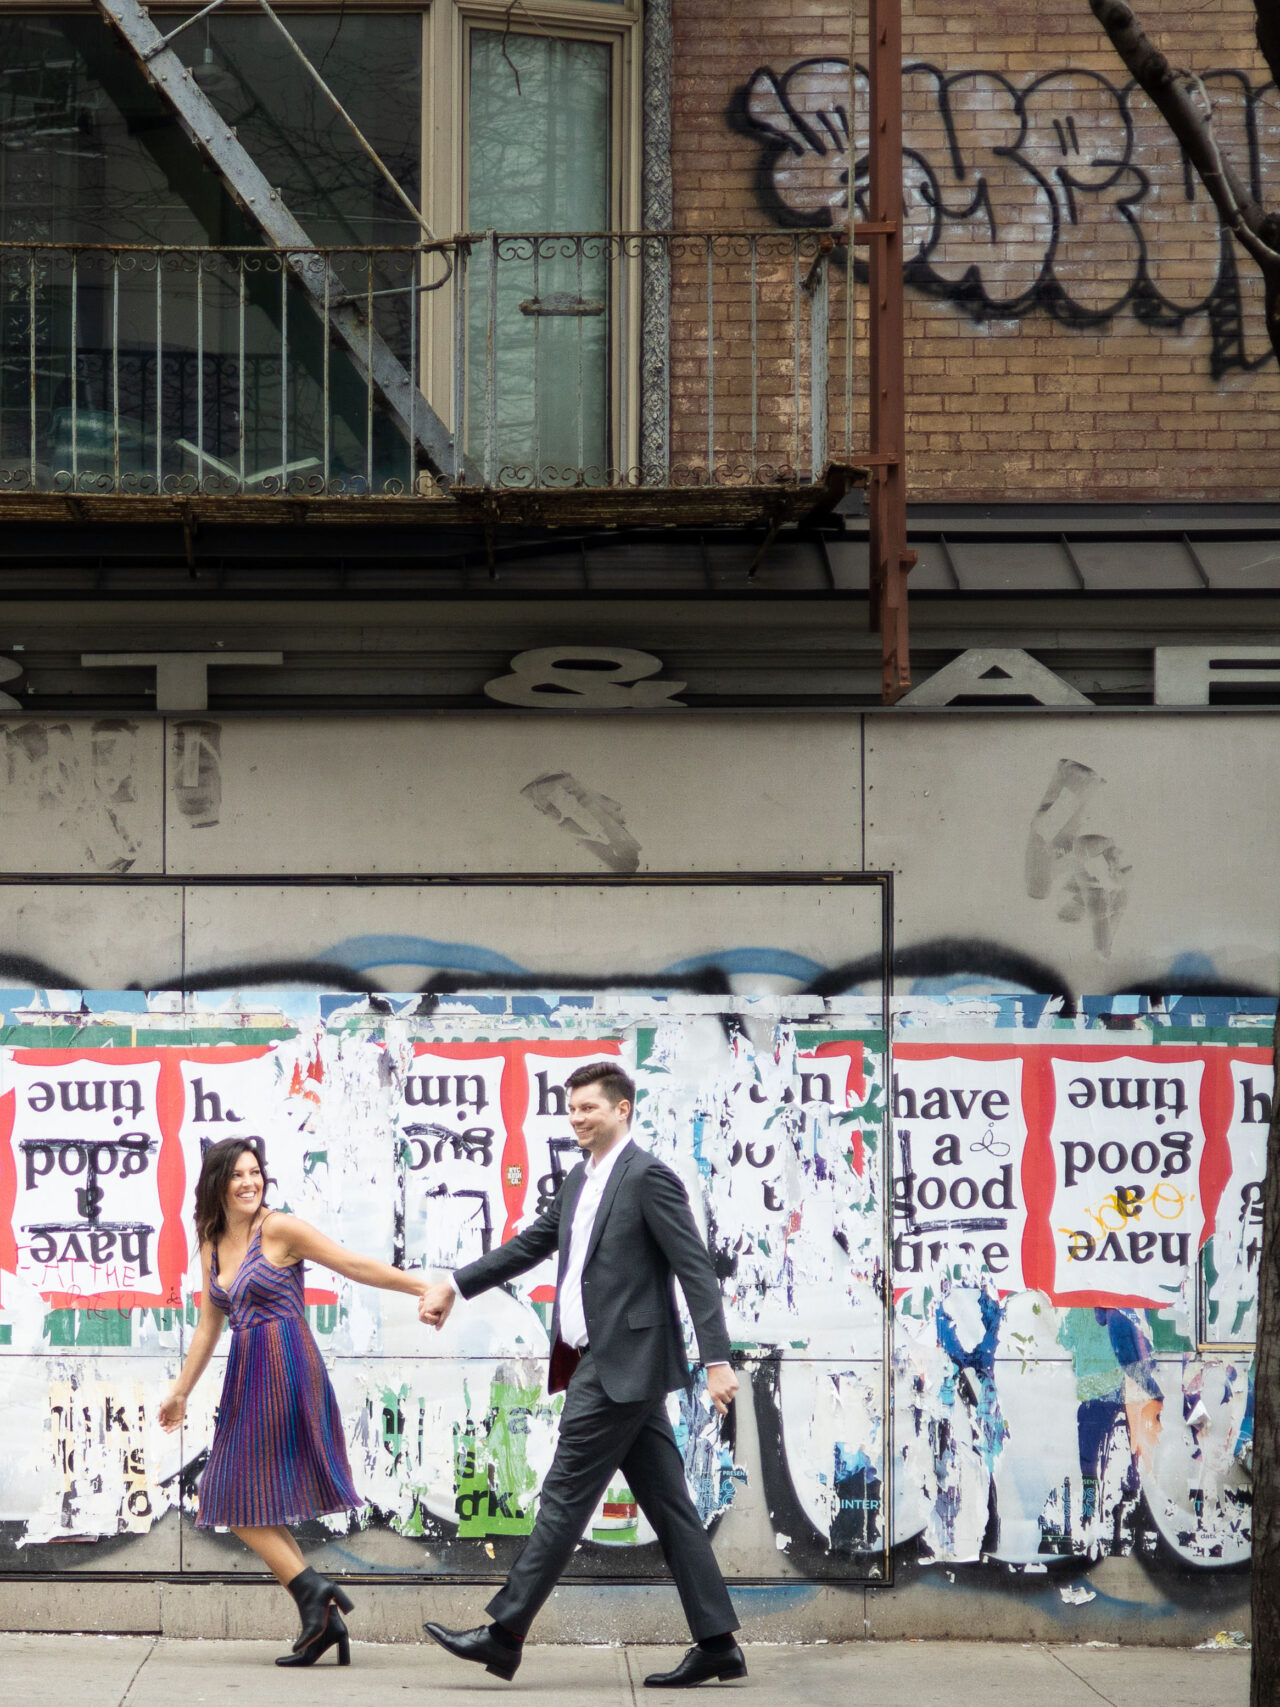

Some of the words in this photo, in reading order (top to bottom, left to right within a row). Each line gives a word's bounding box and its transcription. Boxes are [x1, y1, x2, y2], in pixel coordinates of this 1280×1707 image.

[484, 646, 688, 709] &
[28, 1079, 145, 1126] time
[404, 1074, 489, 1121] tim
[893, 1072, 1010, 1121] have
[1067, 1077, 1188, 1125] time
[23, 1132, 151, 1191] good
[932, 1133, 963, 1166] a
[1060, 1131, 1194, 1188] good
[893, 1163, 1018, 1219] good
[1114, 1184, 1146, 1218] a
[30, 1231, 153, 1278] have
[893, 1231, 1010, 1274] tie
